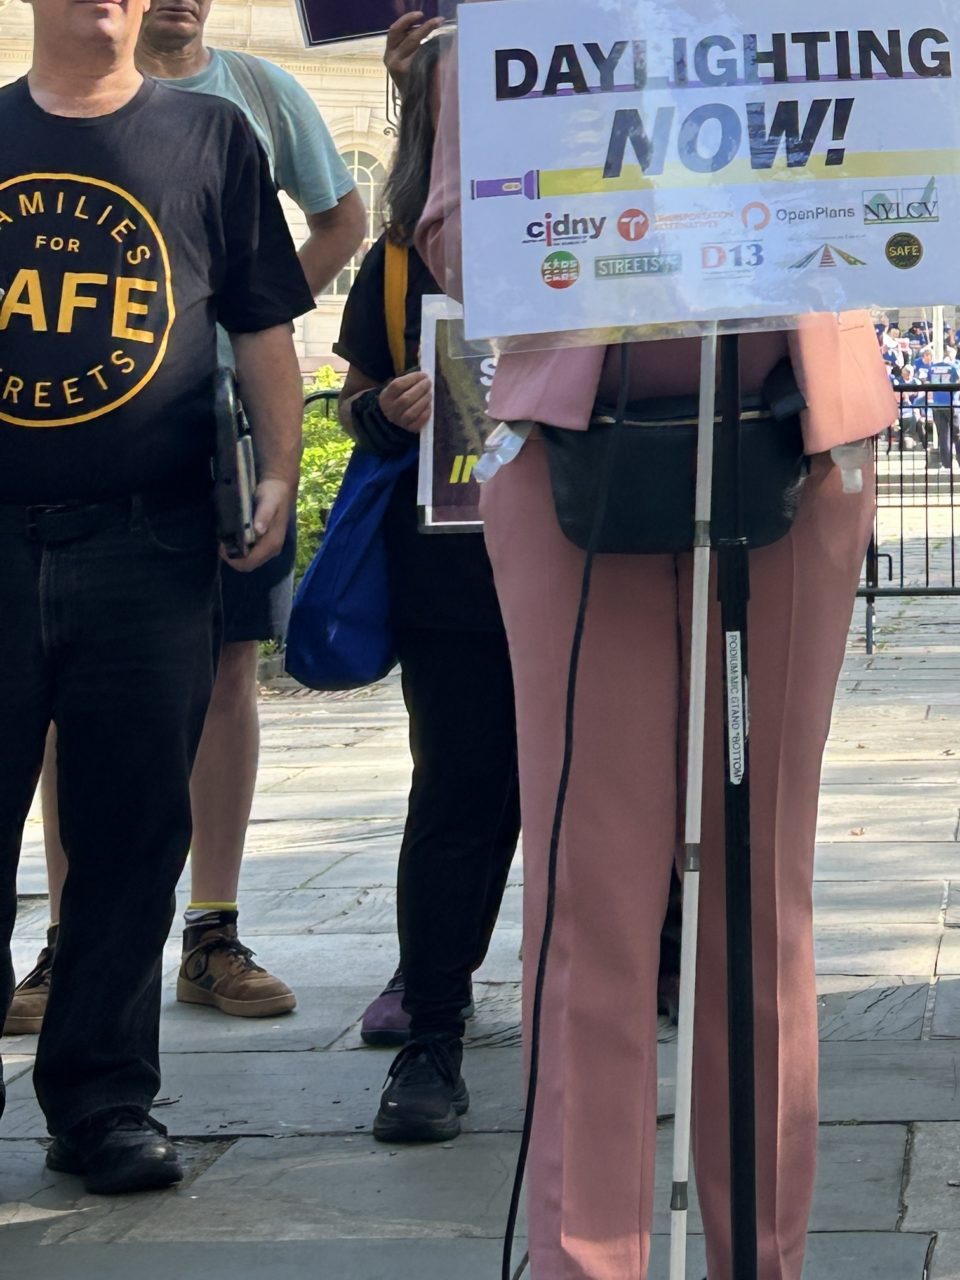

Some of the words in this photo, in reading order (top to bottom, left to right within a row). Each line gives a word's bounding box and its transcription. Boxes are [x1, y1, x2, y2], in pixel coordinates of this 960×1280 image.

[494, 28, 952, 101] DAYLIGHTING
[602, 98, 855, 179] NOW!
[776, 206, 855, 226] OpenPlans
[863, 200, 938, 220] NYLCV
[35, 235, 80, 252] FOR
[526, 212, 606, 247] cidny
[702, 243, 764, 269] D13
[889, 245, 919, 256] SAFE
[0, 268, 157, 344] AFE
[3, 350, 135, 407] REETS
